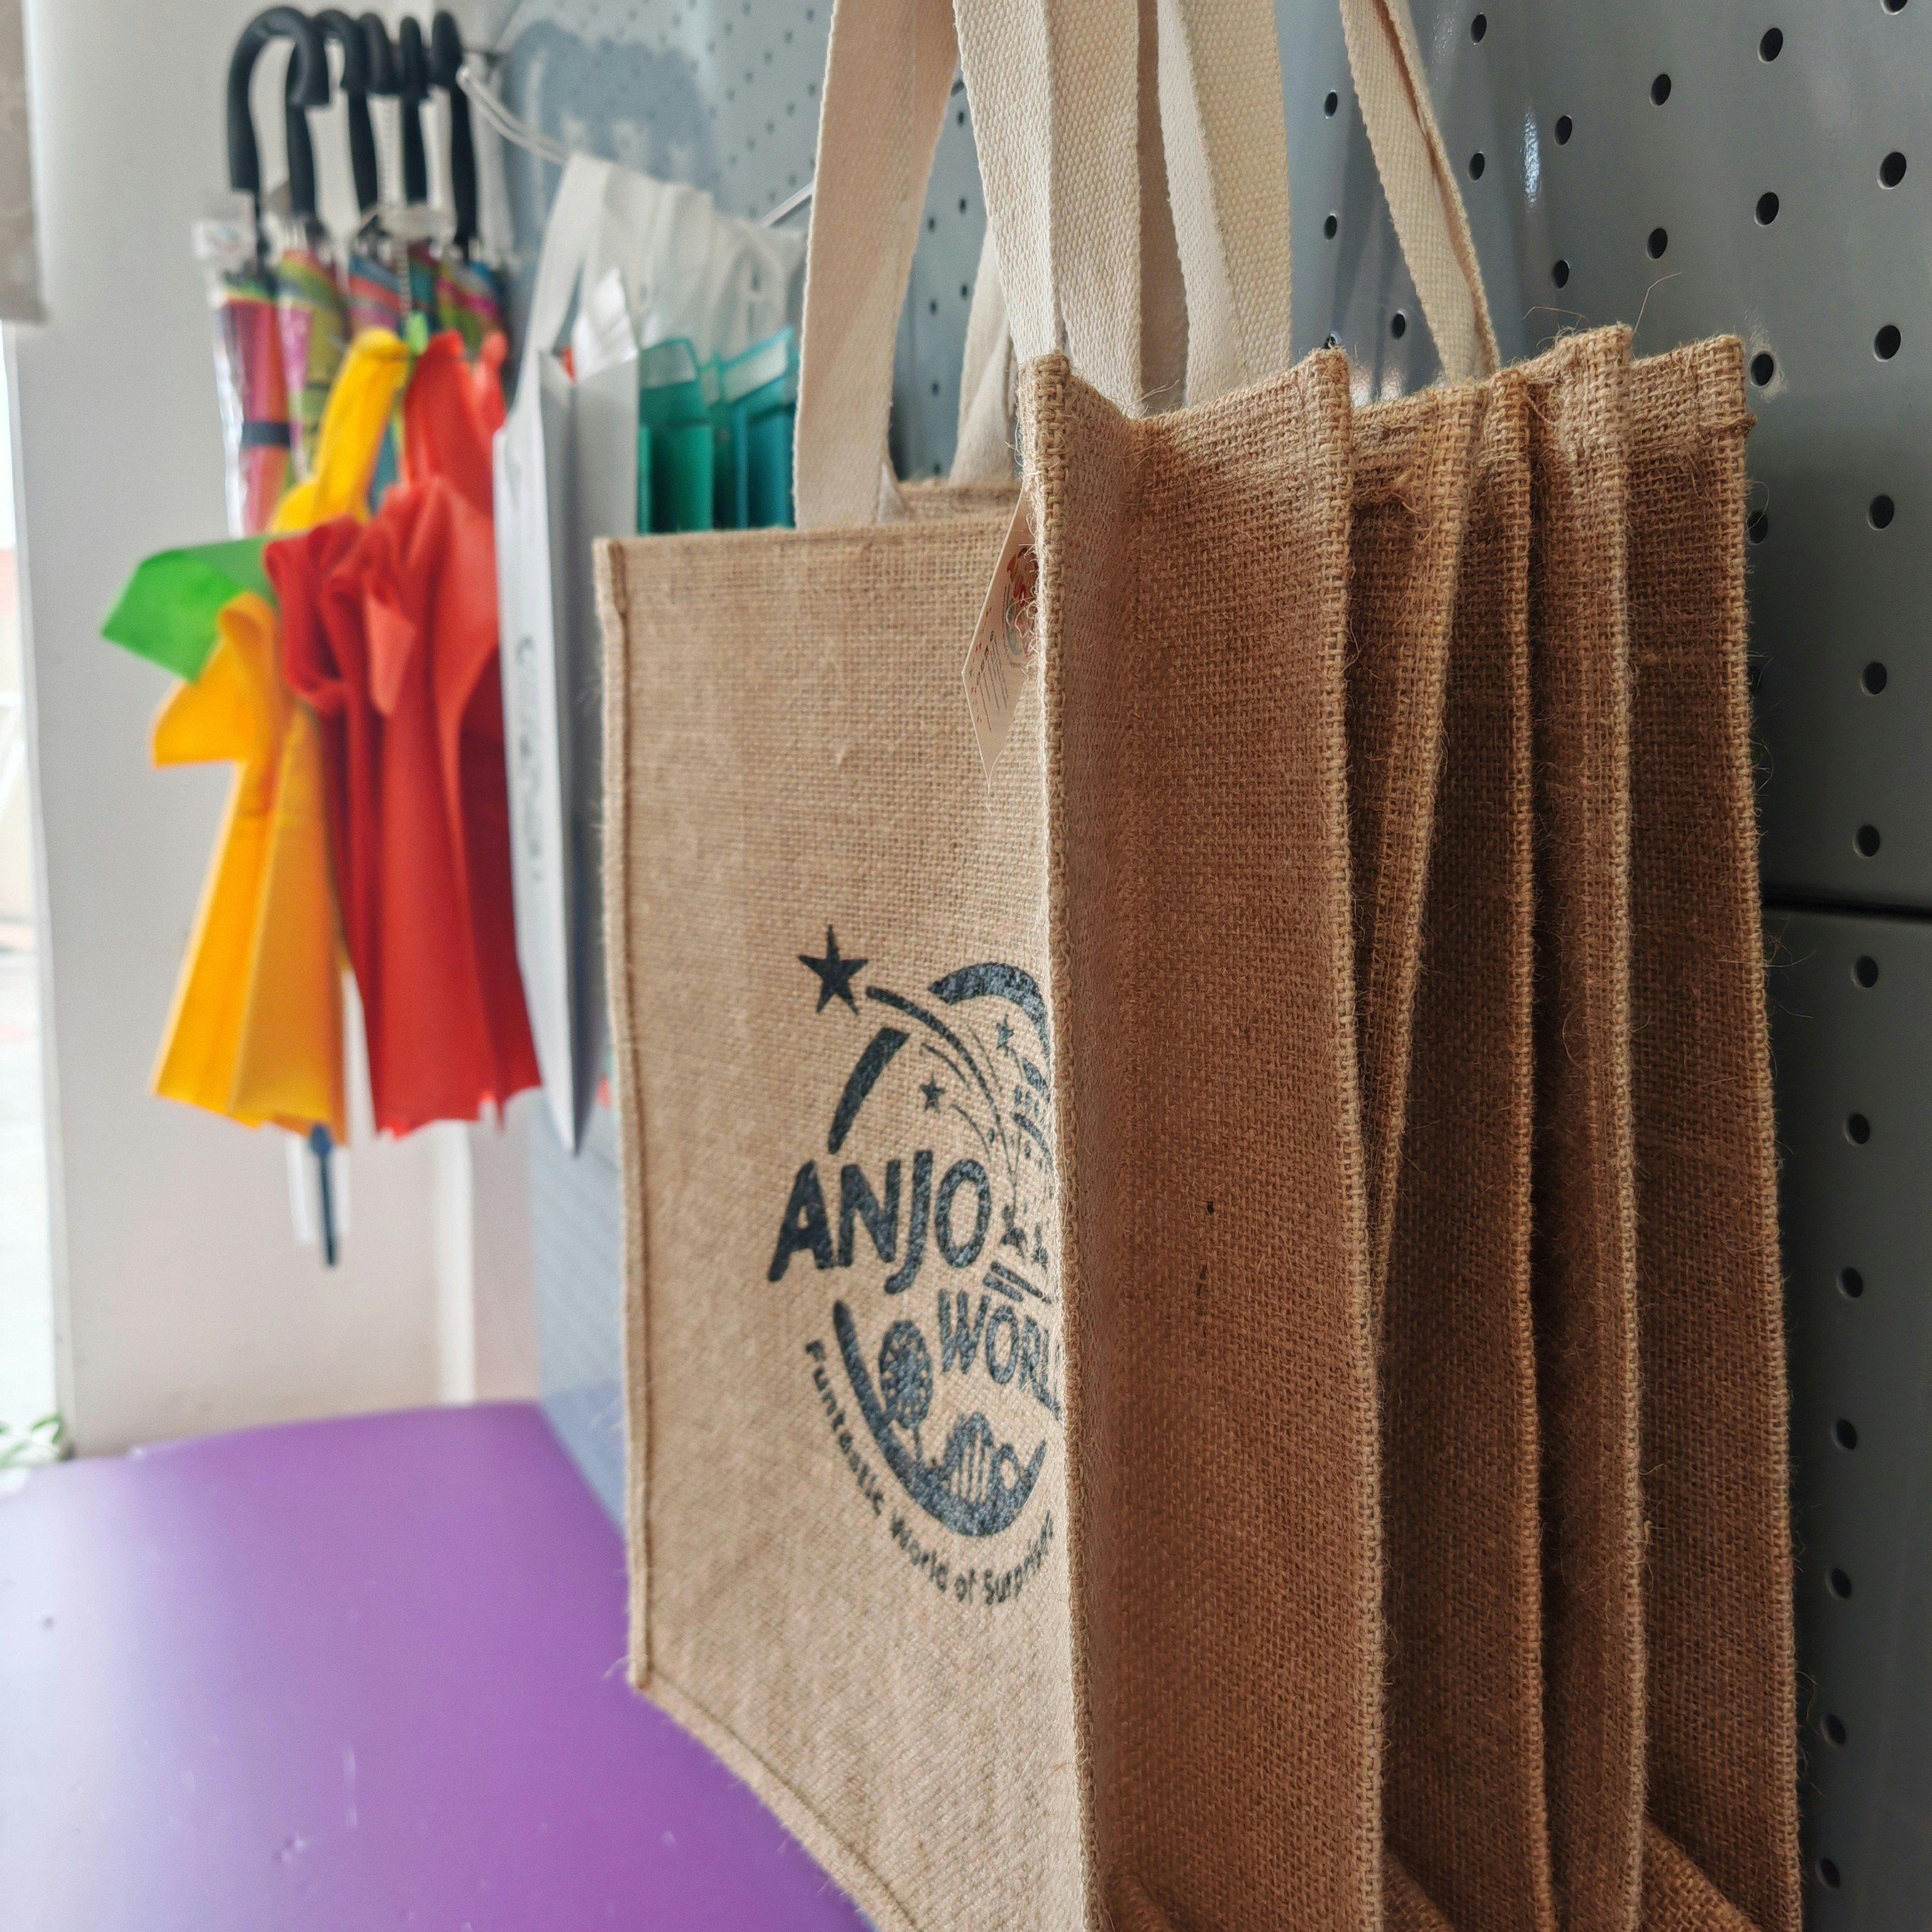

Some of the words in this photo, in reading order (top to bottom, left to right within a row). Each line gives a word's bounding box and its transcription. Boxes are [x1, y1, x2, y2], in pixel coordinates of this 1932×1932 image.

[767, 1150, 992, 1294] ANJO
[938, 1288, 1057, 1394] WORL
[891, 1509, 948, 1592] World
[953, 1568, 976, 1604] of
